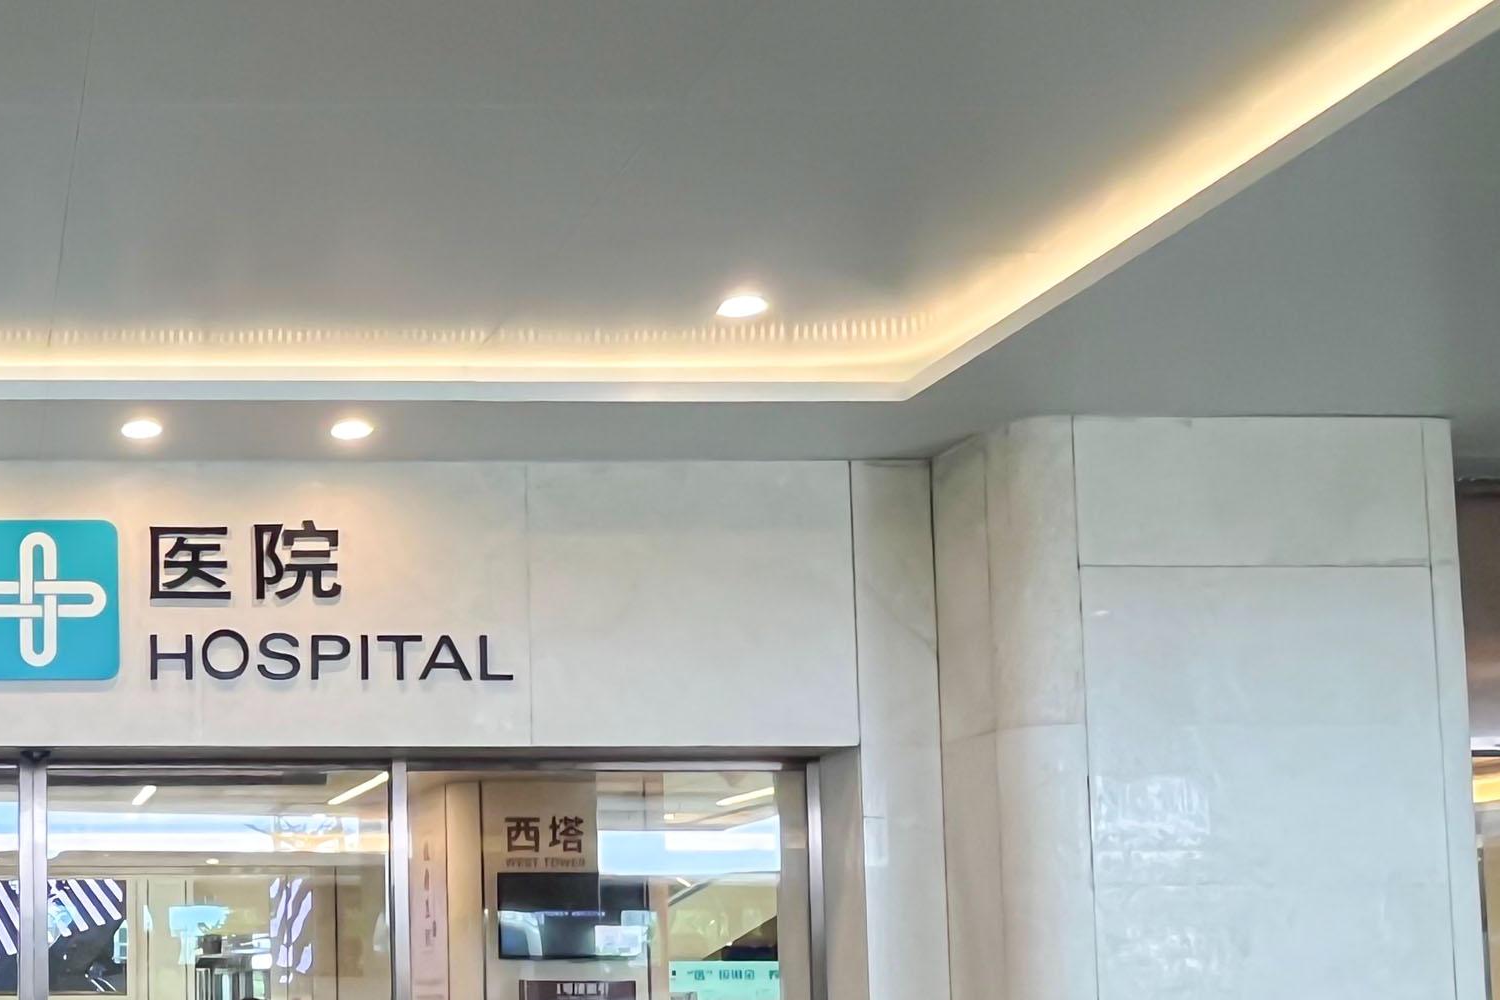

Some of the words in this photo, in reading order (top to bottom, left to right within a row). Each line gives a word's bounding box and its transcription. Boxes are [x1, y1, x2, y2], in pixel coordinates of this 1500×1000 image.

[149, 520, 342, 601] 医院
[150, 629, 514, 681] HOSPITAL
[504, 815, 584, 853] 西塔
